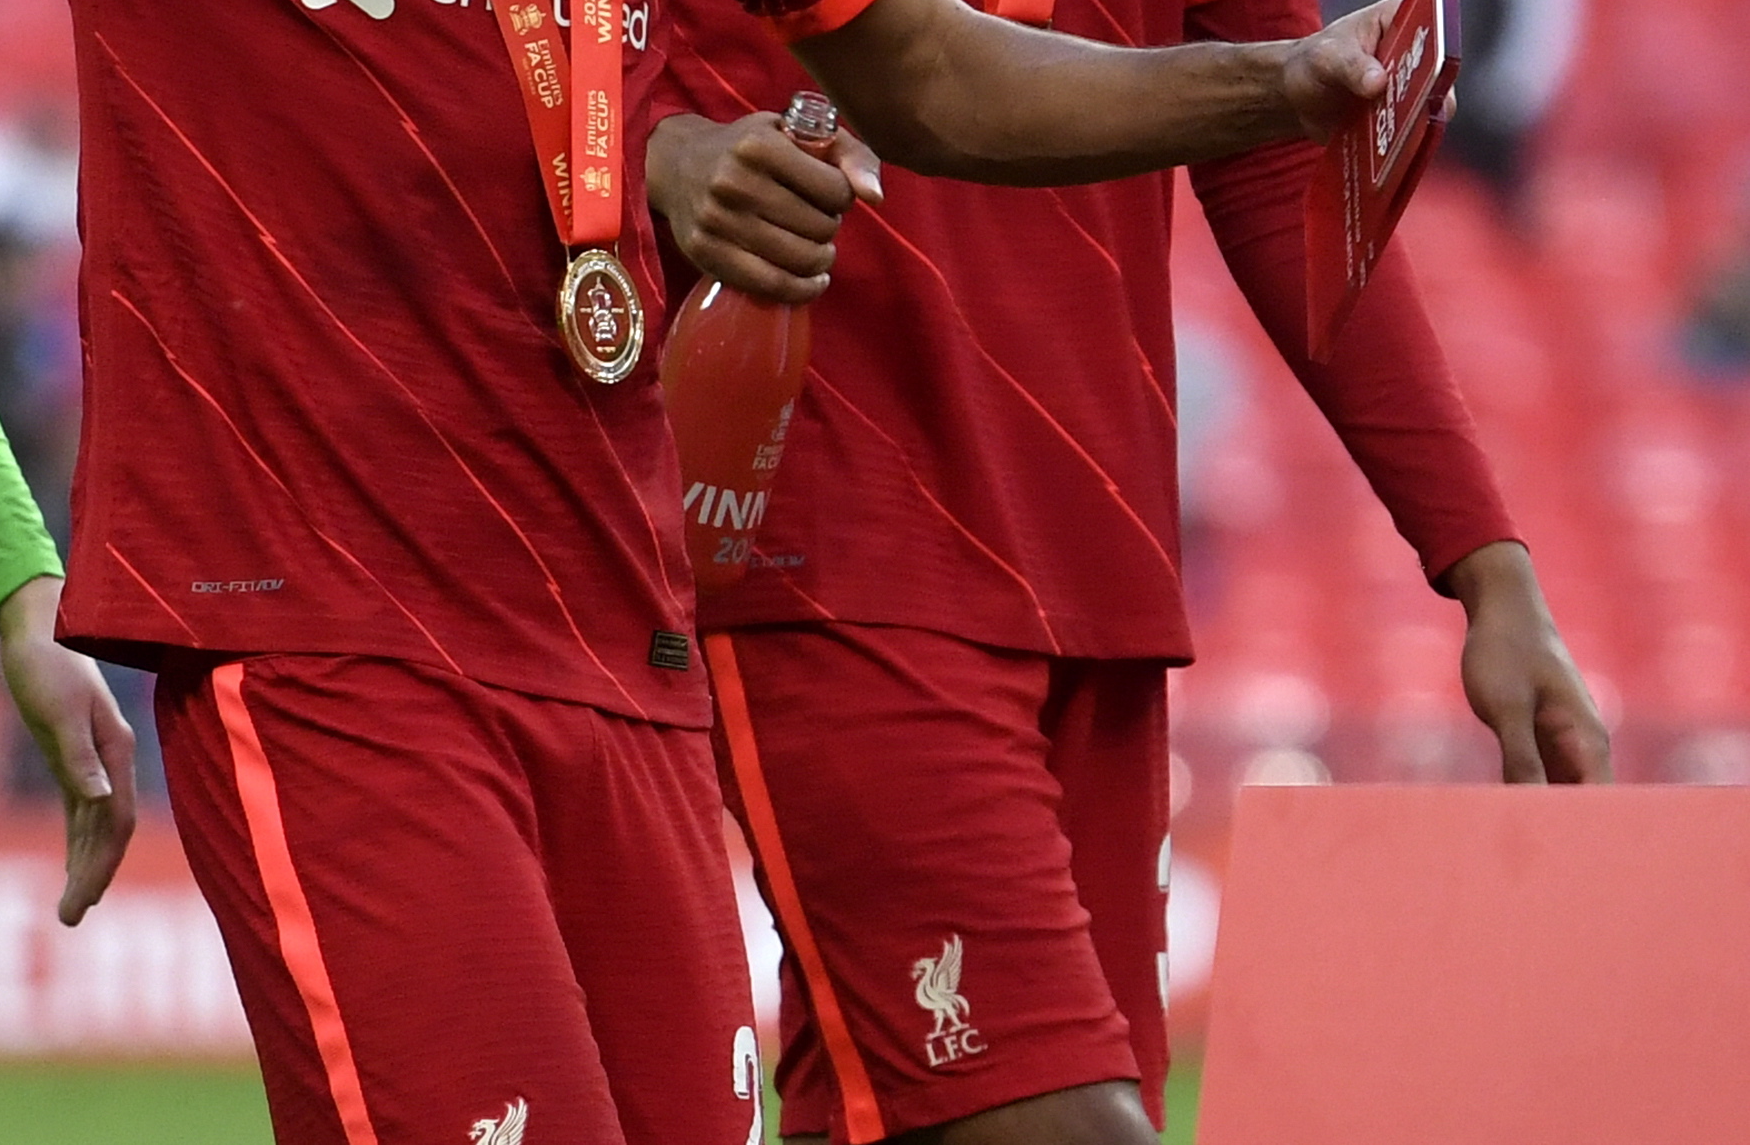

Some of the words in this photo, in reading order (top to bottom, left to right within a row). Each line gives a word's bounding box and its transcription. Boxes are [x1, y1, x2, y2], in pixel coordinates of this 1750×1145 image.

[524, 41, 542, 67] FA
[534, 68, 554, 108] CUP
[538, 39, 564, 106] Emirates
[585, 90, 597, 155] Emirates
[597, 90, 609, 131] CUP
[596, 135, 608, 158] FA
